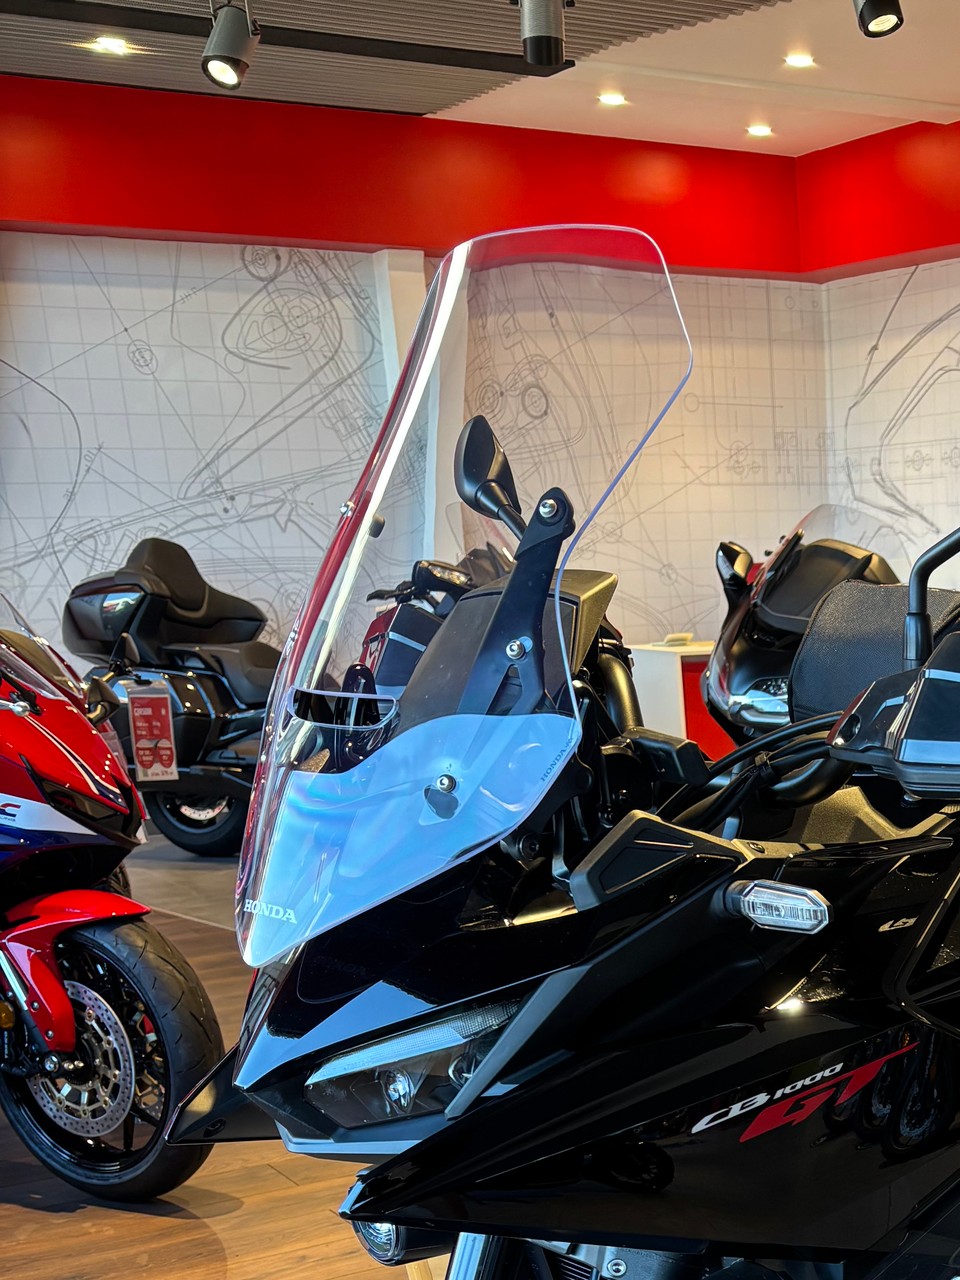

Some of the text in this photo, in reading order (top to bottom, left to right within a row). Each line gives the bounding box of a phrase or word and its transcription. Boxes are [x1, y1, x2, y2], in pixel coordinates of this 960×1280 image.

[540, 749, 567, 782] HONDA
[243, 898, 298, 925] HONDA
[739, 1041, 921, 1143] GT
